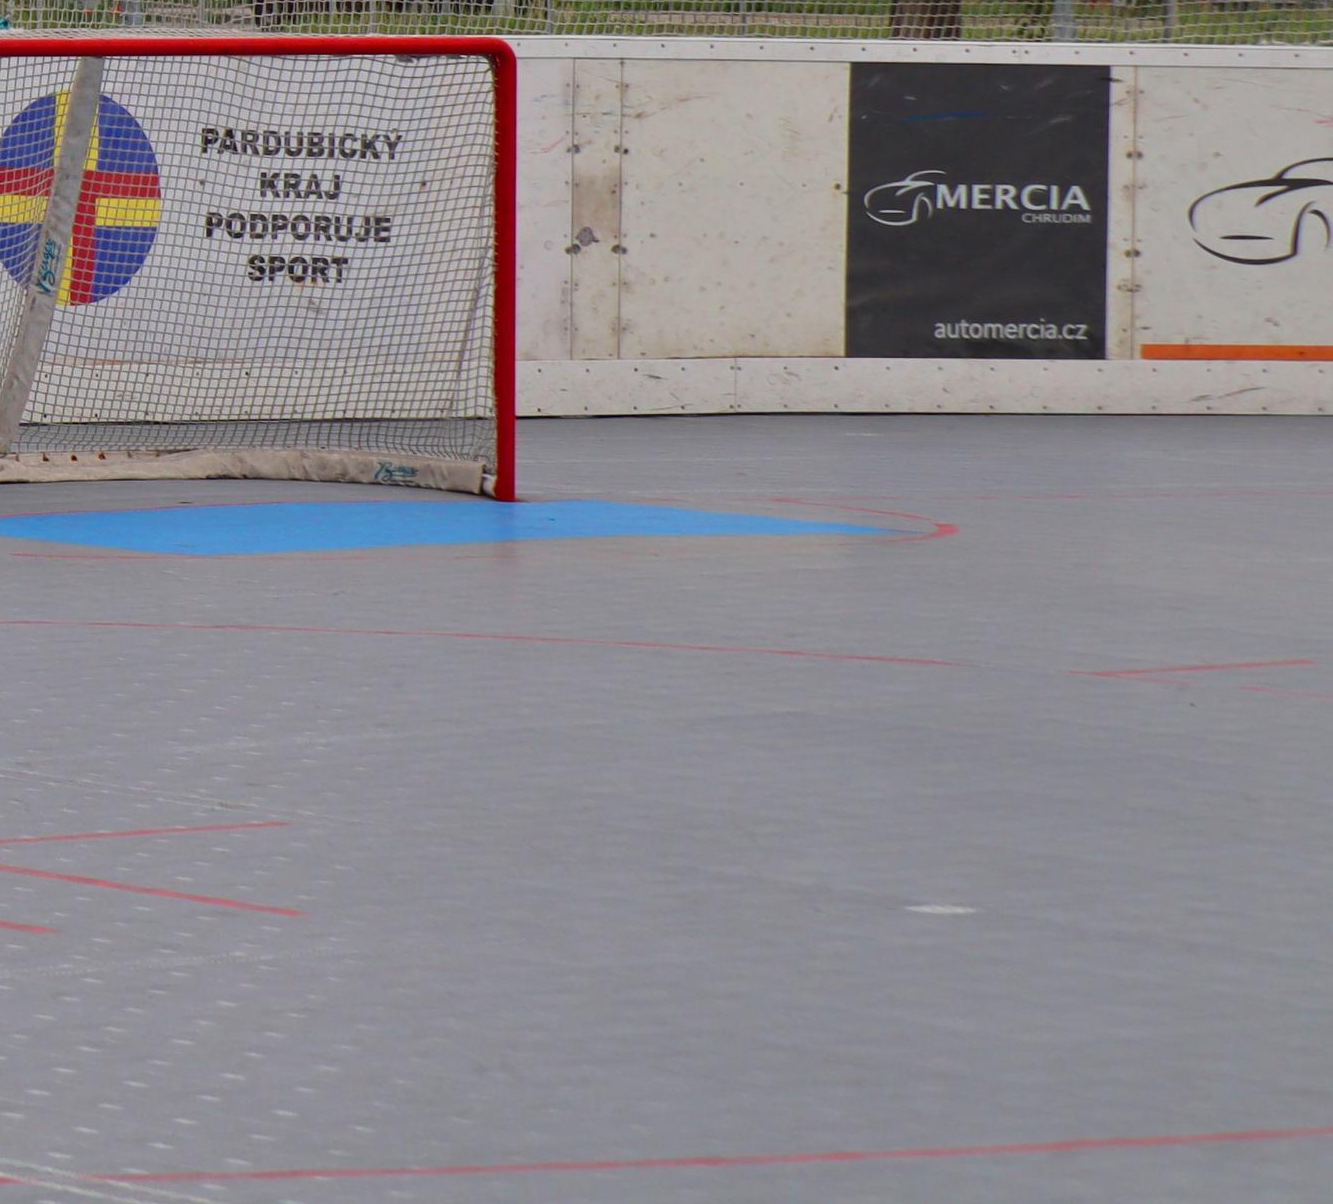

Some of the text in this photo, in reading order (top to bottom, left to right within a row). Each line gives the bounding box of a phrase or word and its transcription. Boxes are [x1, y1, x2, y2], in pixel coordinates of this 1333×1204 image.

[199, 125, 404, 161] PARDUBICKÝ
[258, 171, 343, 201] KRAJ
[936, 183, 1091, 211] MERCIA
[205, 211, 393, 244] PODPORUJE
[1021, 212, 1092, 224] CHRUDIM
[247, 254, 350, 285] SPORT
[933, 317, 1089, 341] automercia.cz
